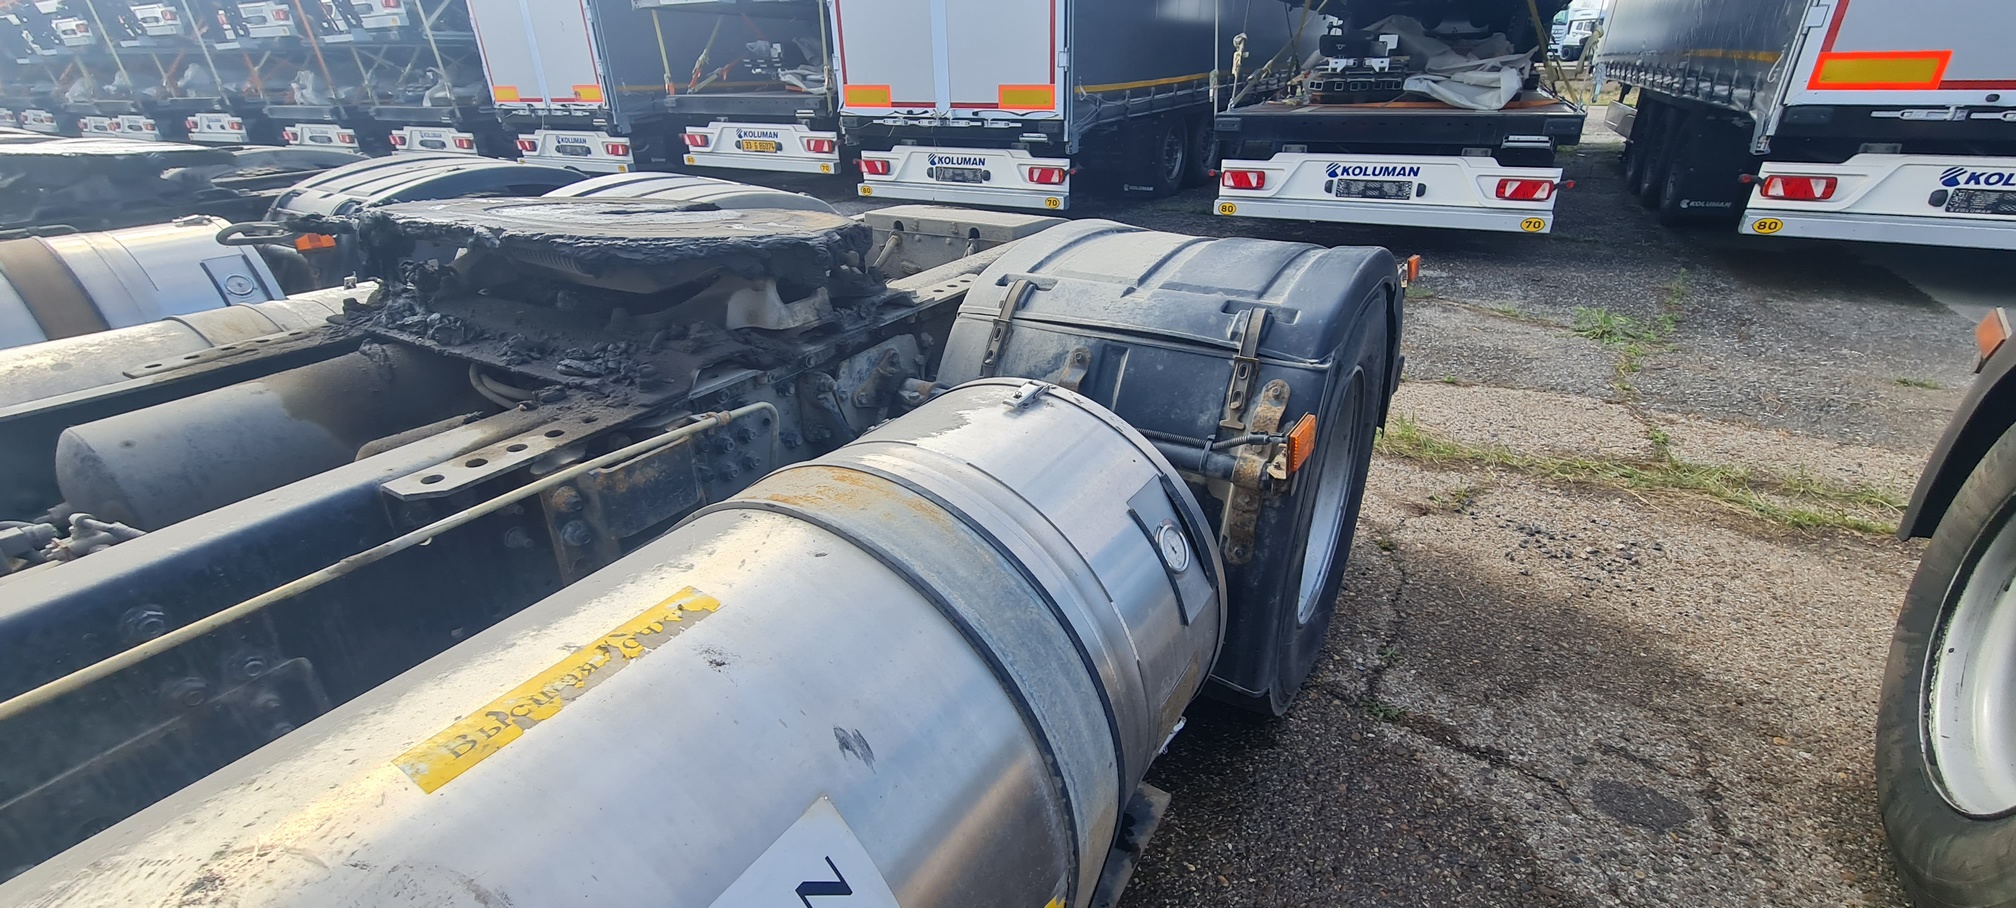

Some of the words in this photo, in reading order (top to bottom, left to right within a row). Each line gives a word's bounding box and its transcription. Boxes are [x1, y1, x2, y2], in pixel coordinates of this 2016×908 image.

[743, 131, 778, 139] KOLUMAN
[937, 156, 985, 166] KOLUMAN
[1341, 166, 1420, 177] KOLUMAN
[1757, 222, 1778, 230] 80
